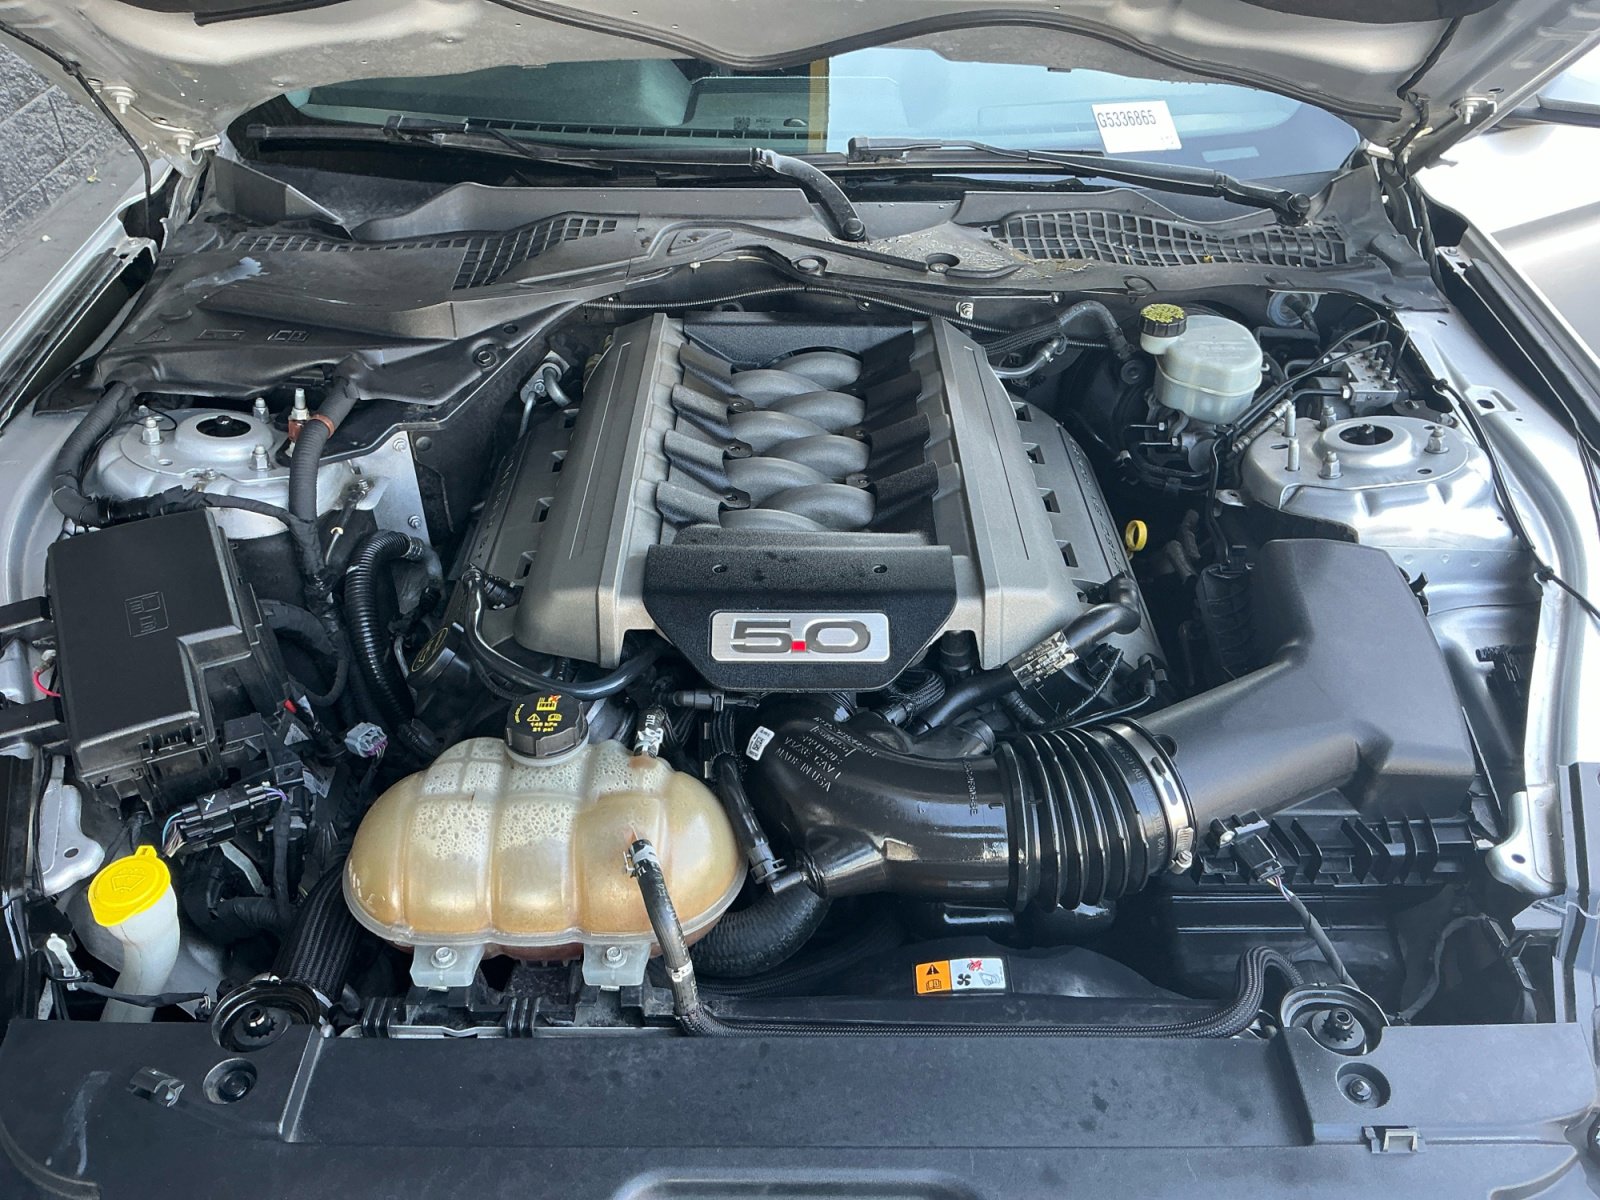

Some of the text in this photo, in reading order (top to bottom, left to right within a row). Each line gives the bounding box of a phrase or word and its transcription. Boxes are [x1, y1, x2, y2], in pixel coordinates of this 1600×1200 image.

[1096, 109, 1157, 128] G5336865
[730, 618, 872, 654] 5.0
[775, 747, 831, 792] MADE IN USA
